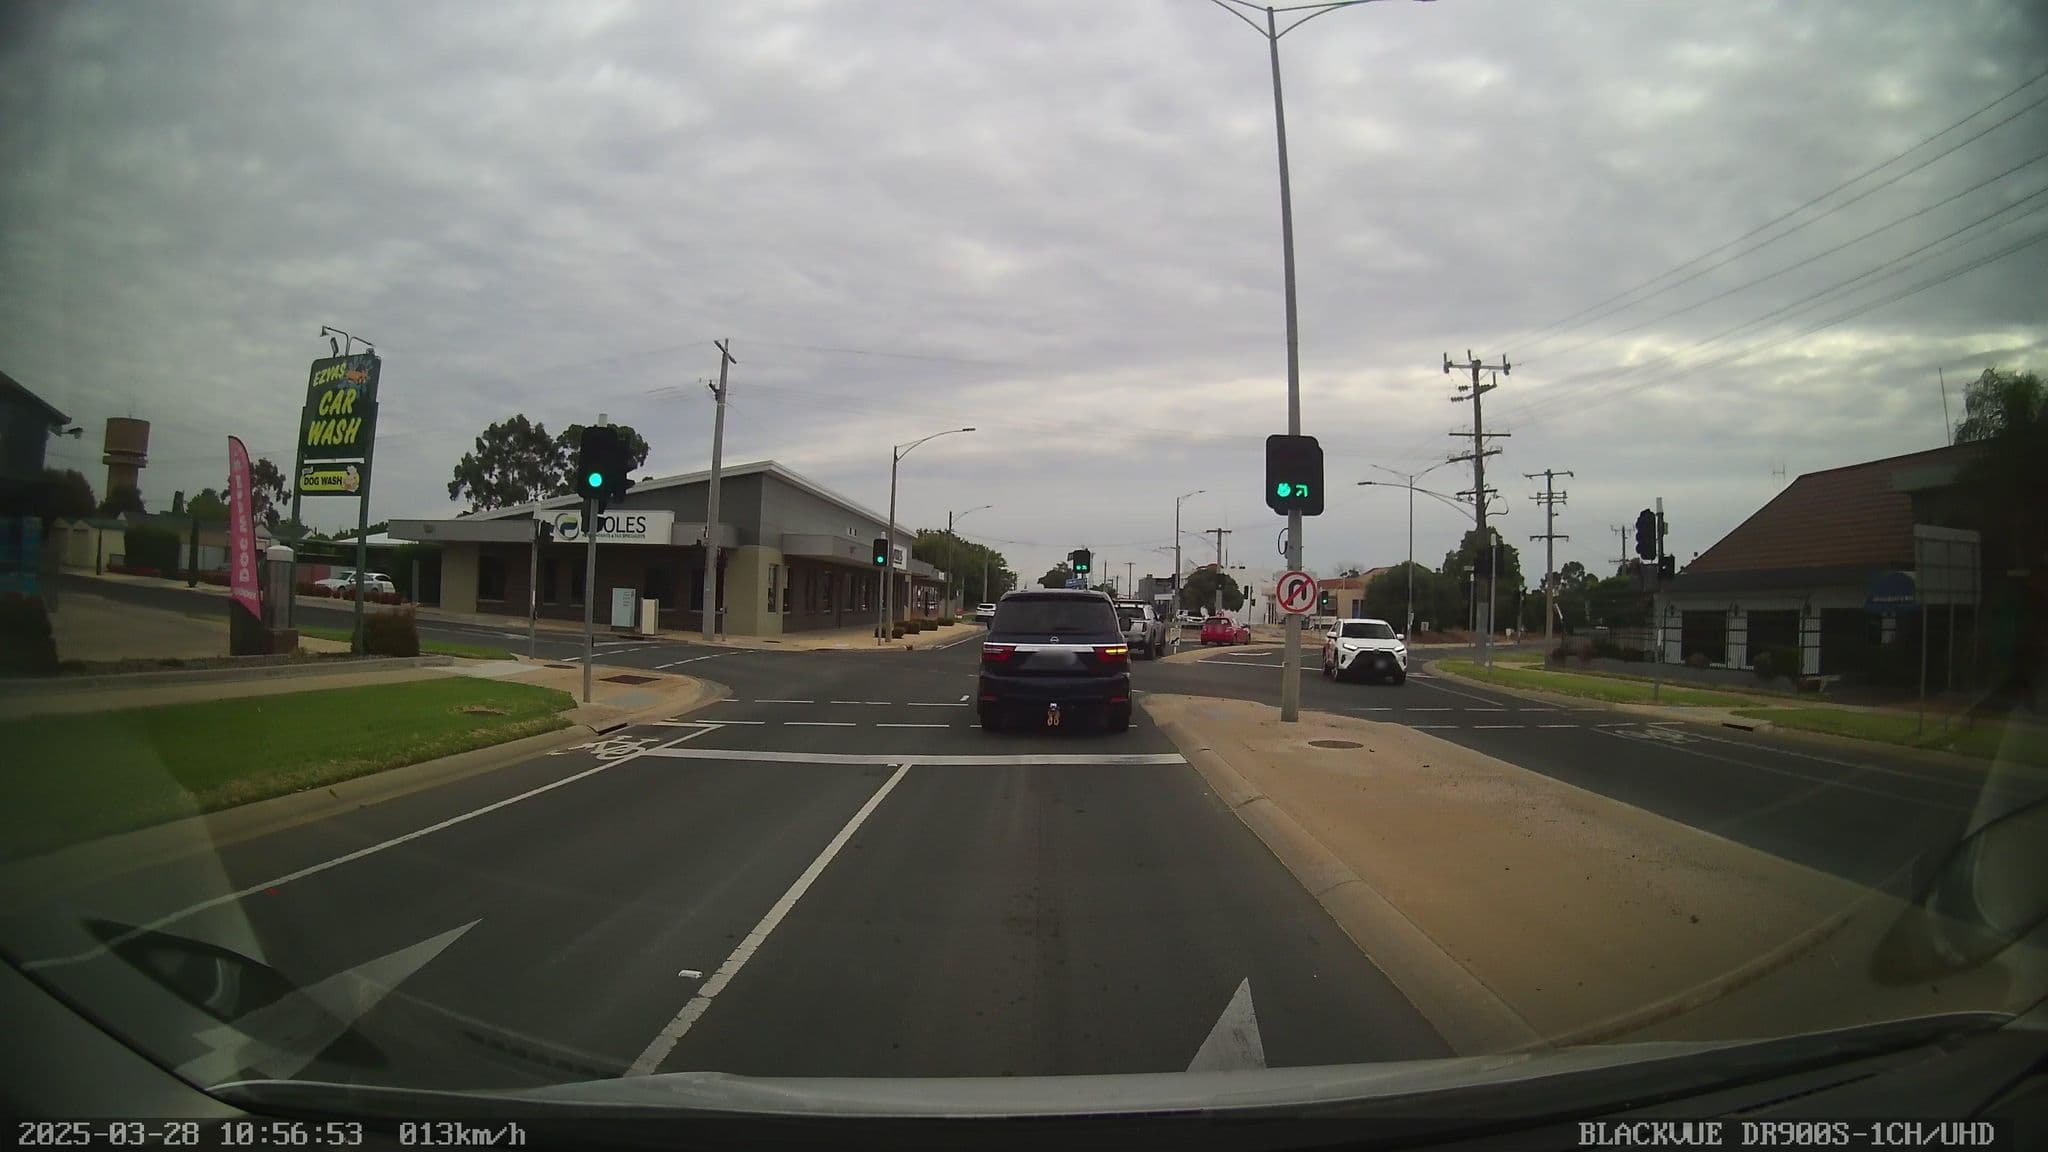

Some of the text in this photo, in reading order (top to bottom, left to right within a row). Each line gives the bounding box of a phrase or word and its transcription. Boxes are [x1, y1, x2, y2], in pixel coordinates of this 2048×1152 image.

[319, 388, 357, 416] CAR
[307, 417, 361, 446] WASH
[303, 475, 343, 486] DOG WASH
